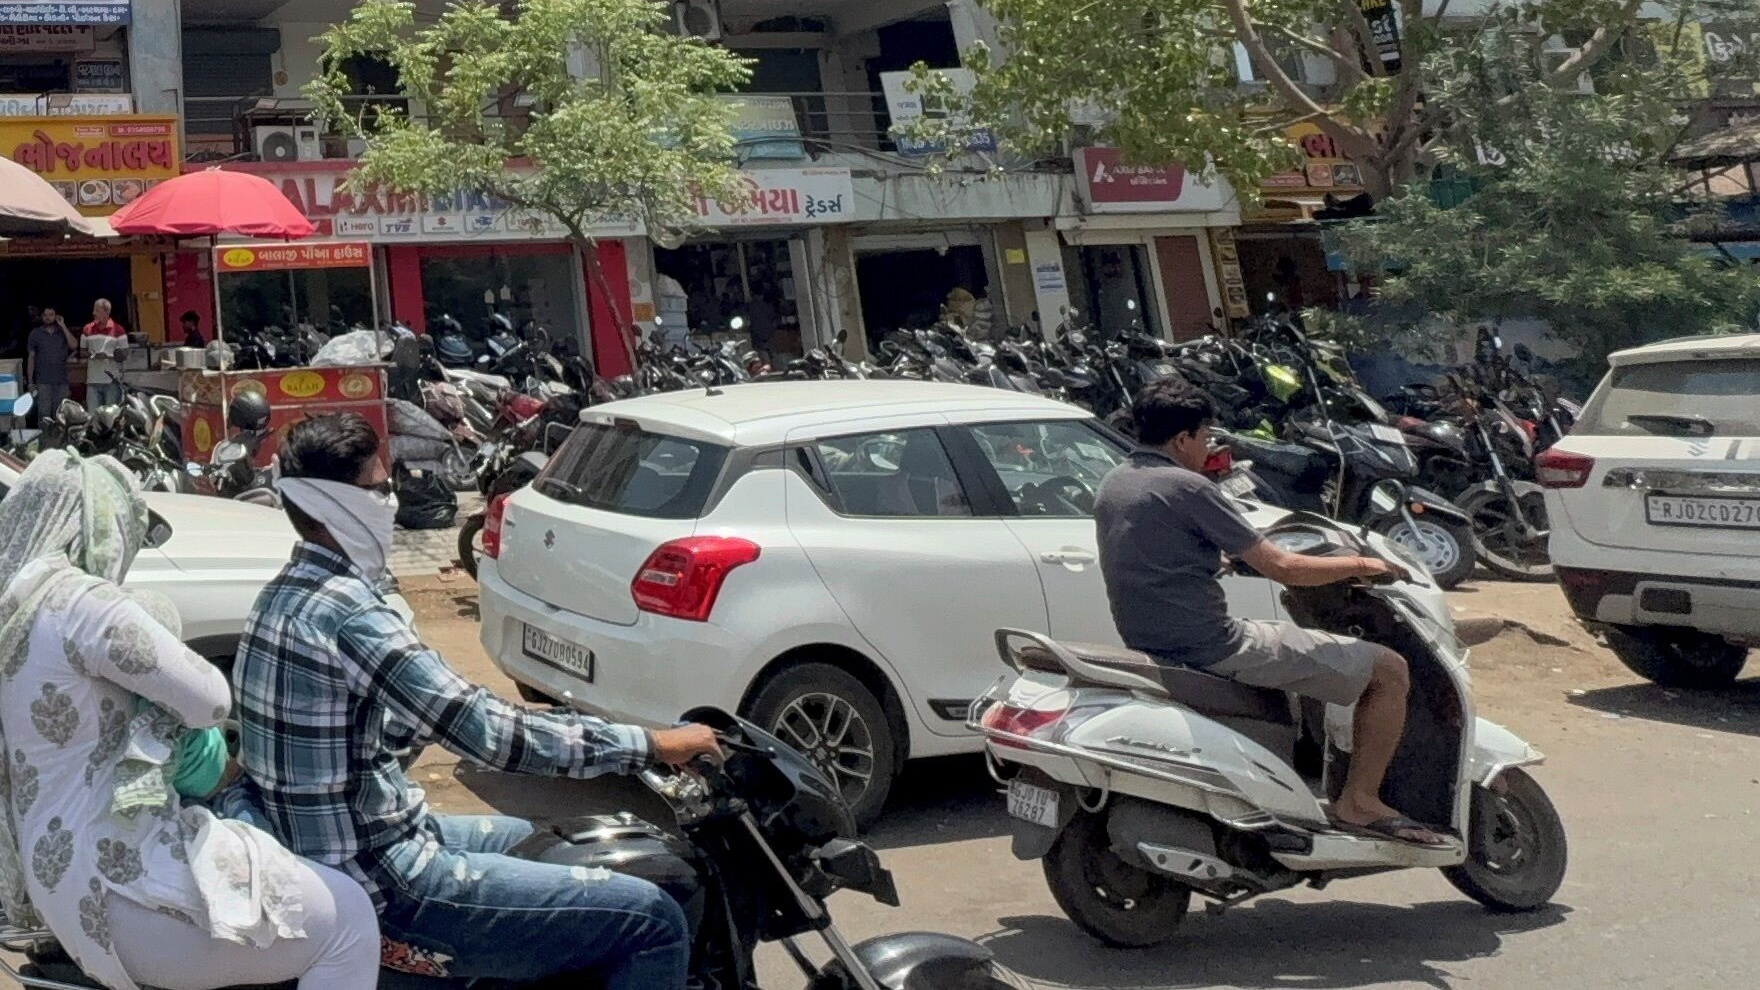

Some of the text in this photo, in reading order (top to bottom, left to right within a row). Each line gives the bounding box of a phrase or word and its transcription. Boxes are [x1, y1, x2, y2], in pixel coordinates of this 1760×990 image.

[14, 130, 173, 172] ભોજનાલય
[351, 223, 374, 231] Hero
[385, 223, 411, 233] TVS
